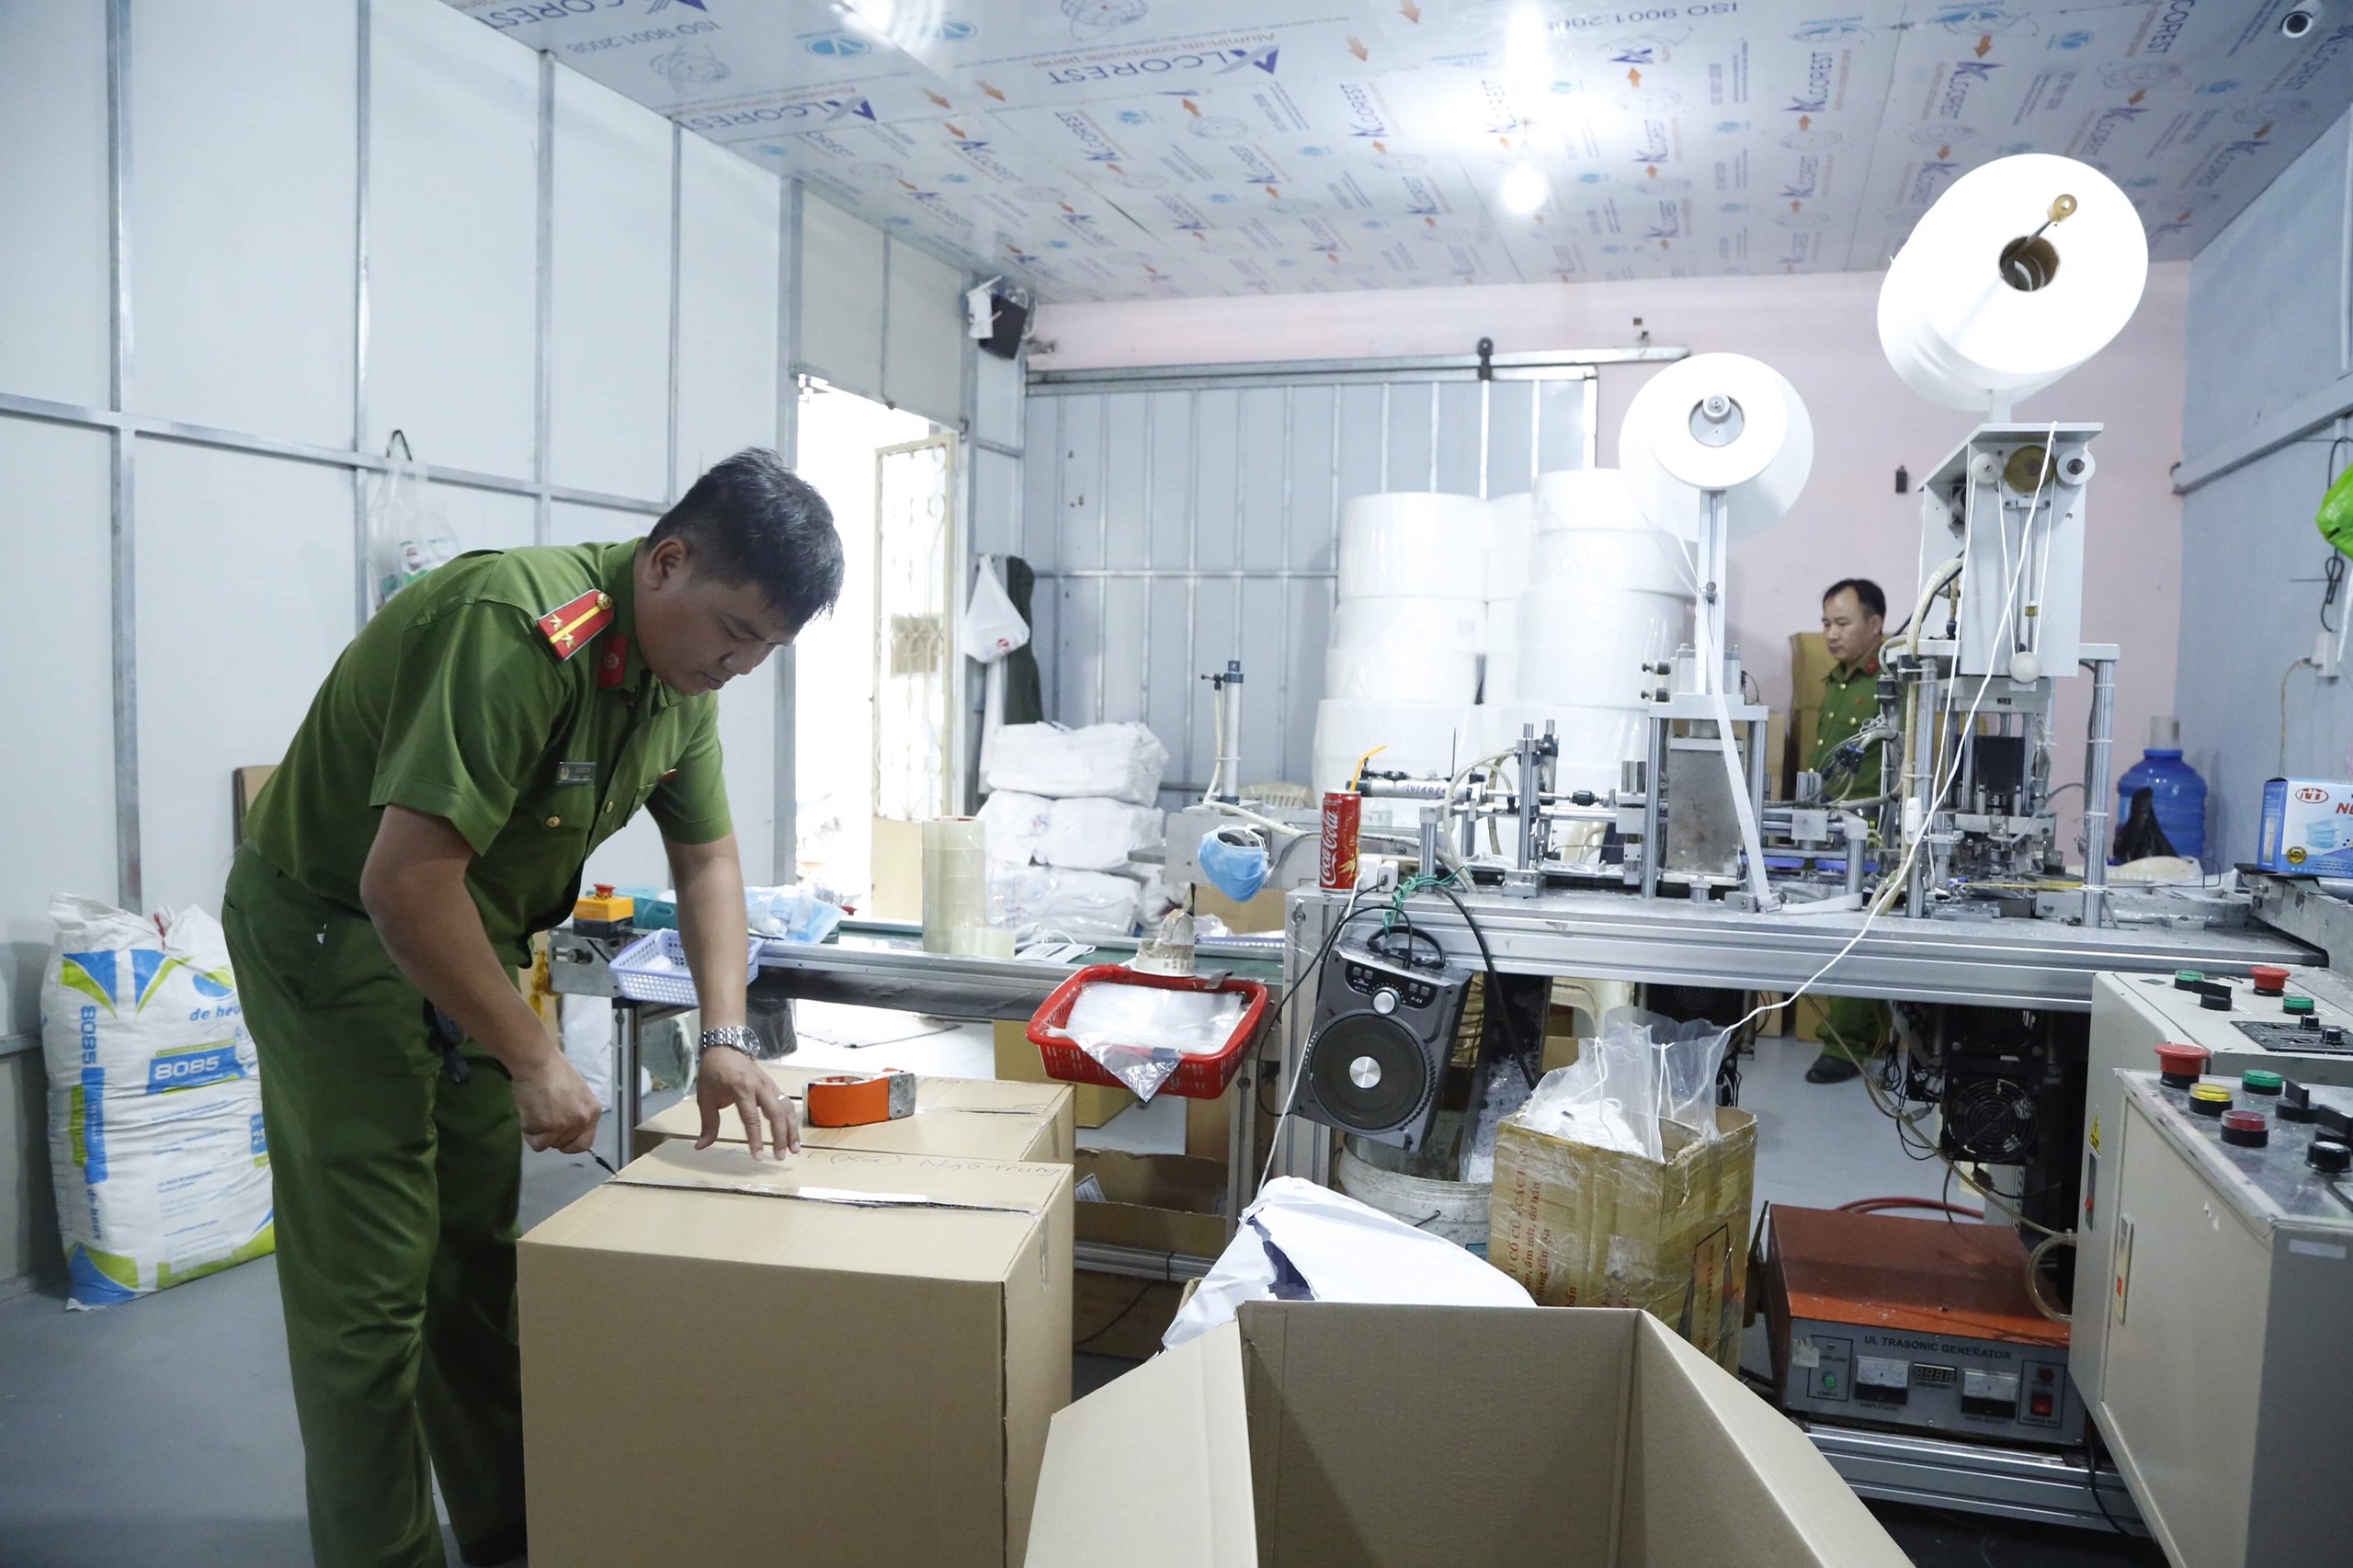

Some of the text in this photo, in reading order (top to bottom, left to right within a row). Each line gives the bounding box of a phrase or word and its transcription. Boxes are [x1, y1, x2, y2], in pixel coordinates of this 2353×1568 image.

[1687, 2, 1737, 17] ISO
[676, 20, 722, 33] ISO
[1048, 44, 1280, 85] ALCOREST
[81, 1006, 97, 1064] 8085
[154, 1057, 221, 1080] 8085
[1941, 1344, 2011, 1360] GENERATOR
